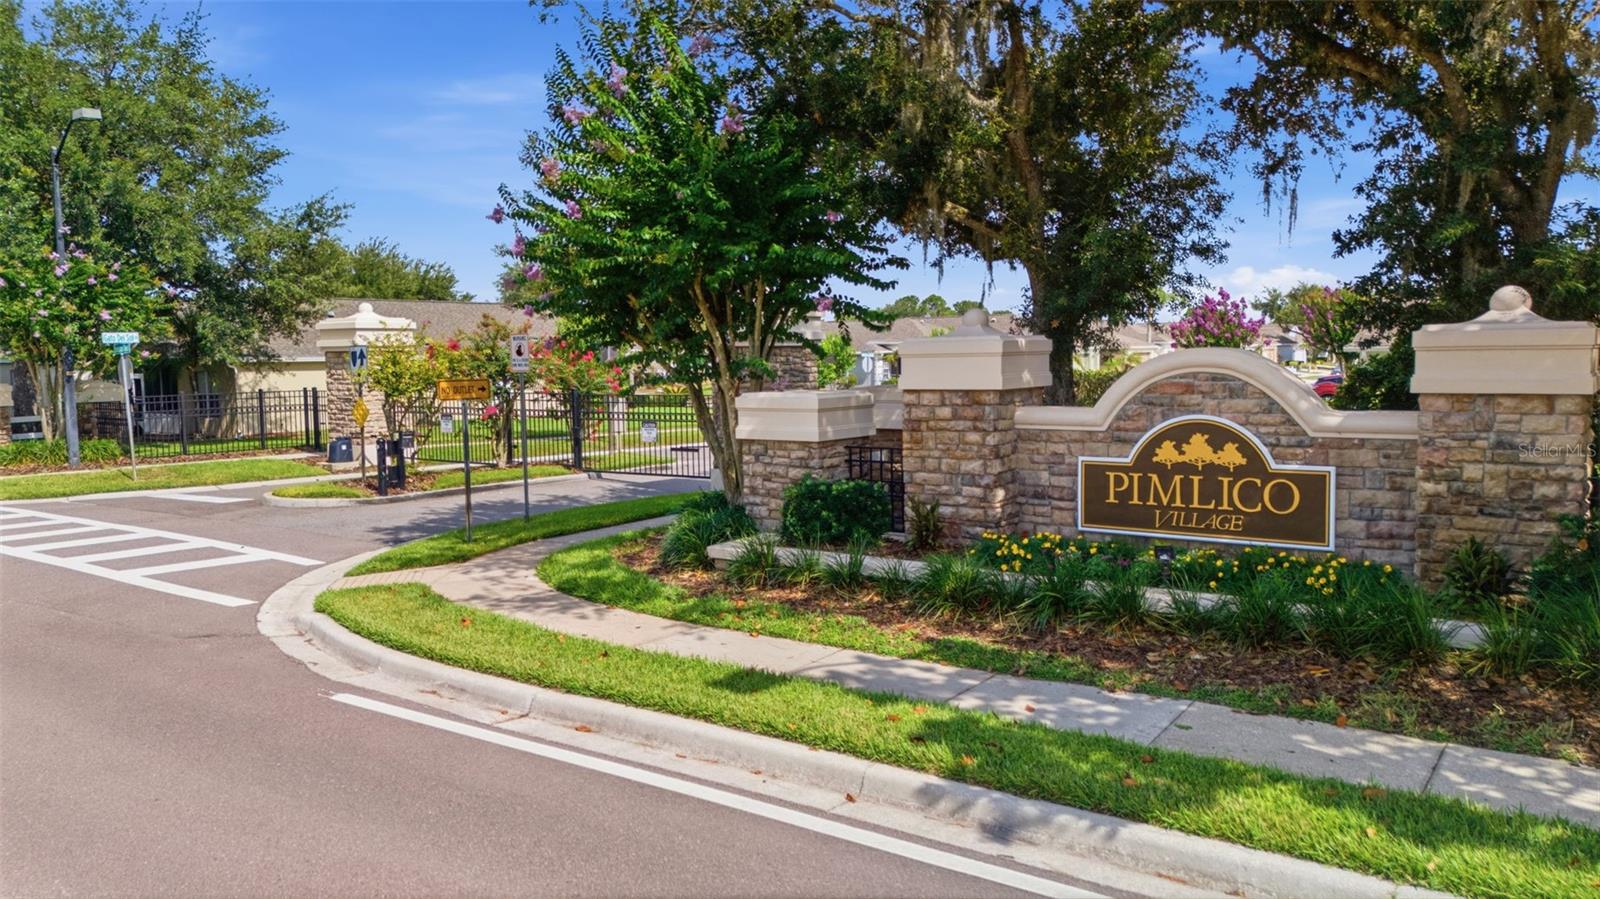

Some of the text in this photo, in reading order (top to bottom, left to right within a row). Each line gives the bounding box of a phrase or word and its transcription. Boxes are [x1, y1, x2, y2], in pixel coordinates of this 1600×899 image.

[441, 385, 475, 395] NO OUTLET
[1104, 471, 1302, 515] PIMLICO
[1153, 509, 1245, 532] VILLAGE
